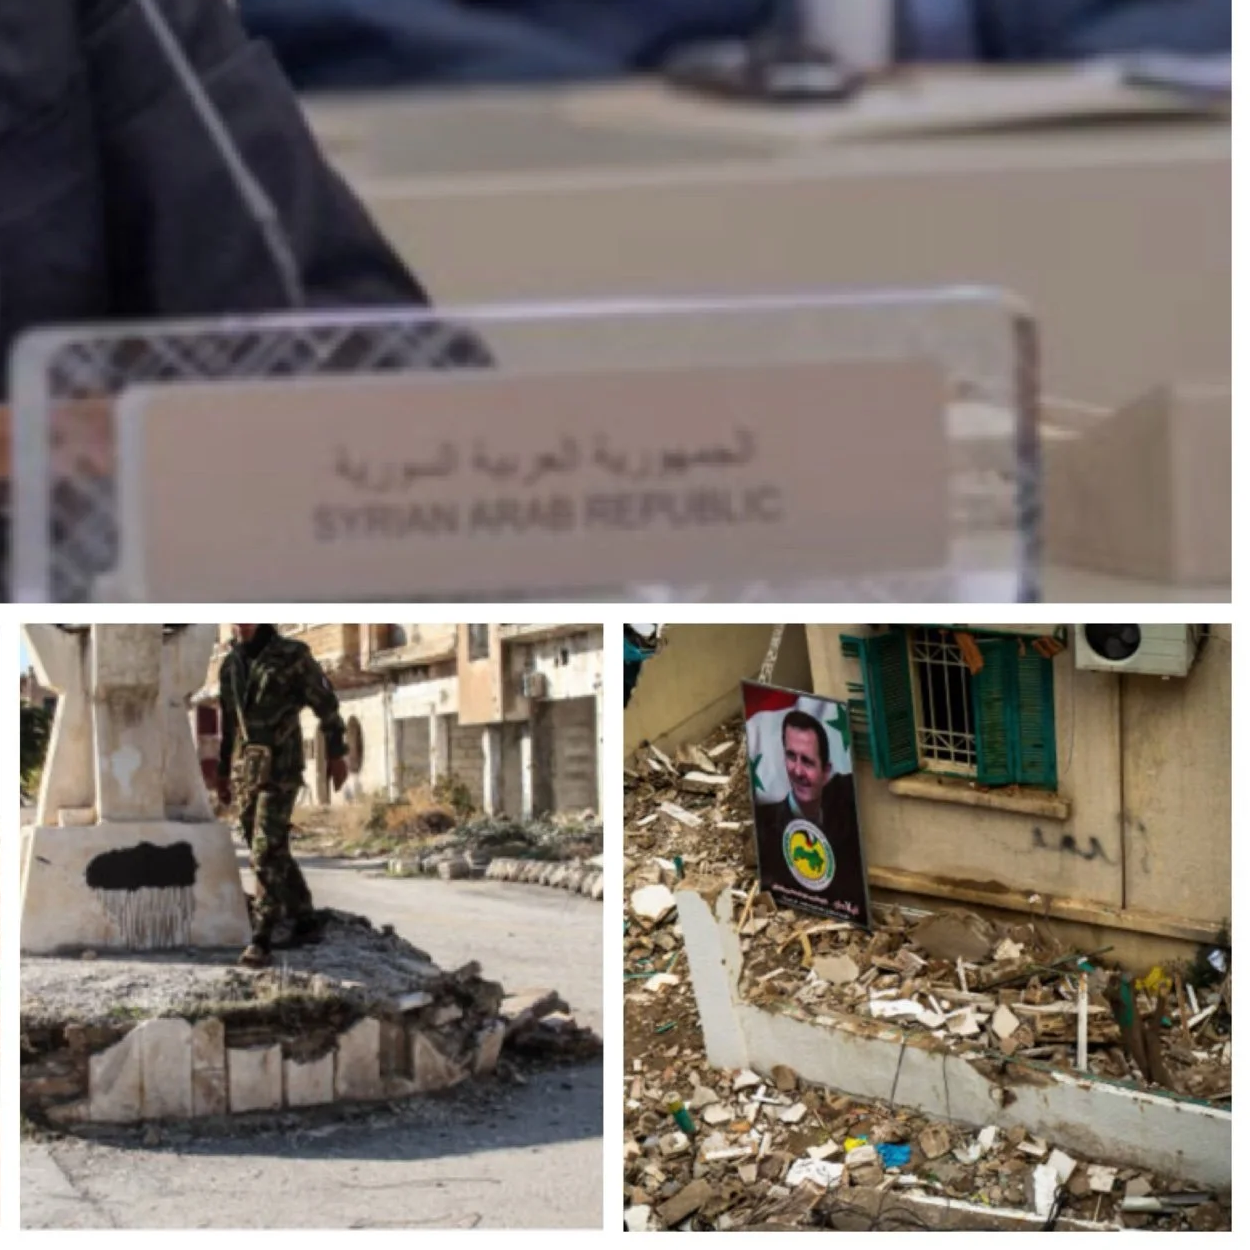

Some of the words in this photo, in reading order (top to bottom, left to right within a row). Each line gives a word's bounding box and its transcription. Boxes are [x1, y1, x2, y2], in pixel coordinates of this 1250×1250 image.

[334, 439, 457, 495] السورية
[470, 434, 579, 488] العربية
[591, 427, 754, 480] الجمهورية
[311, 502, 458, 541] SYRIAN
[469, 494, 576, 535] ARAB
[585, 486, 784, 528] REPUBLIC
